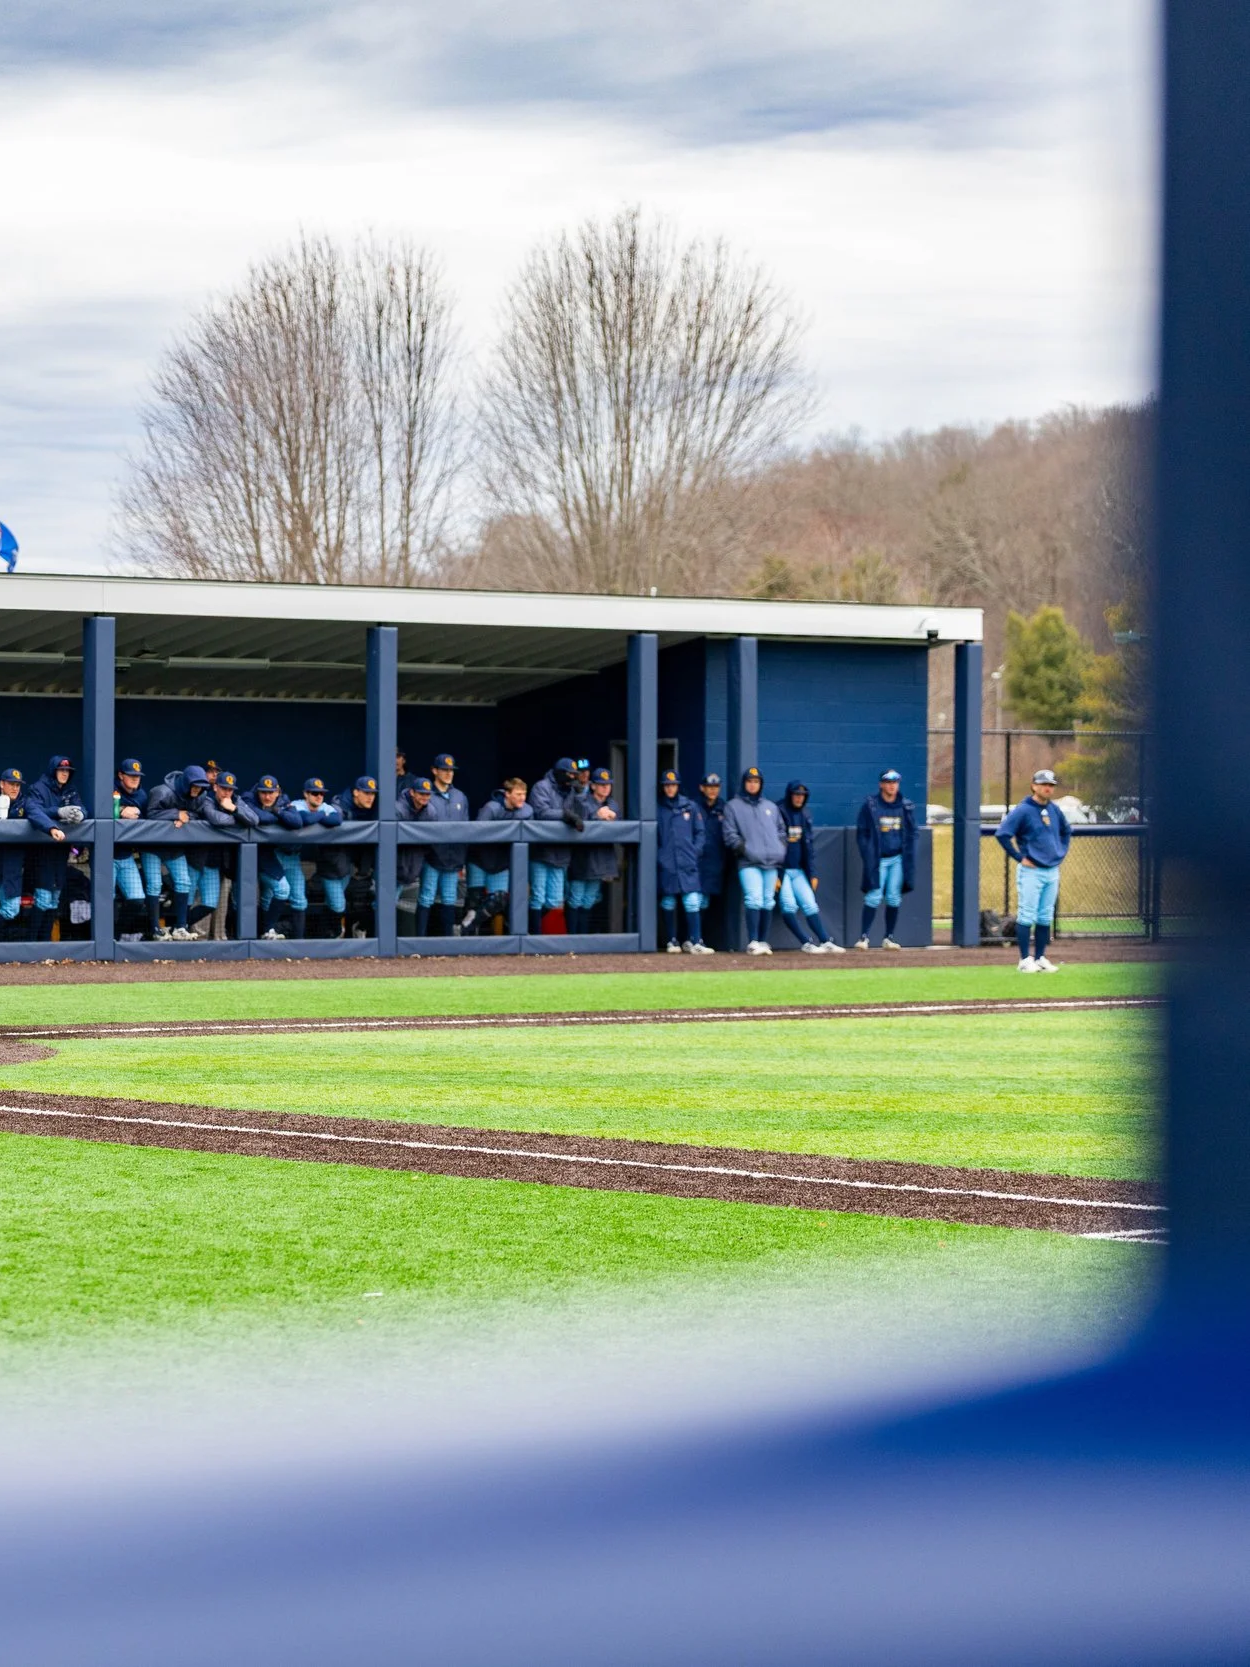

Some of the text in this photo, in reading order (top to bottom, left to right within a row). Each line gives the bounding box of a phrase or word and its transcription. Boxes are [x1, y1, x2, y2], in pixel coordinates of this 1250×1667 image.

[132, 762, 141, 772] Q
[12, 769, 21, 780] Q
[226, 775, 234, 785] Q
[264, 779, 273, 789] Q
[314, 779, 324, 789] Q
